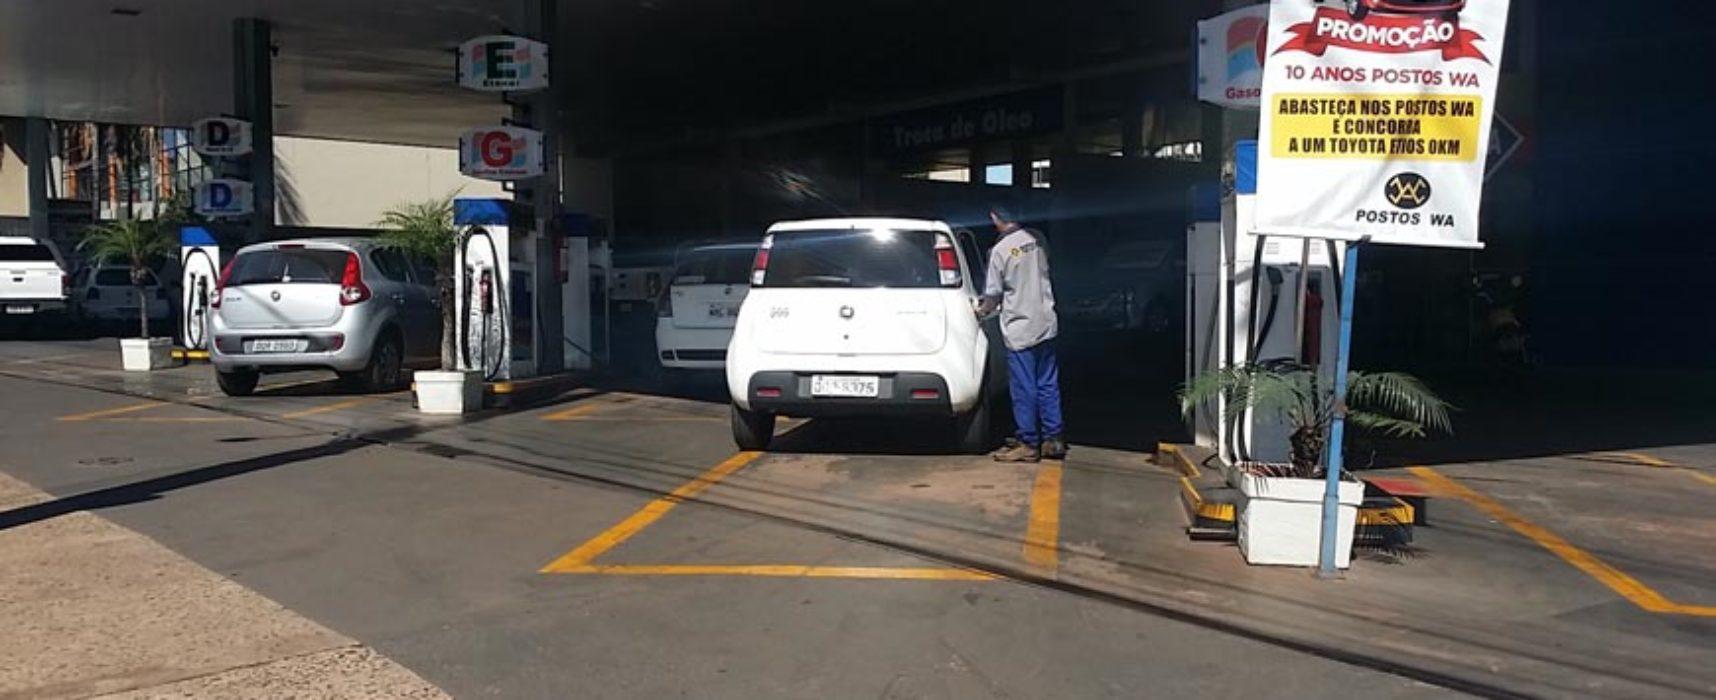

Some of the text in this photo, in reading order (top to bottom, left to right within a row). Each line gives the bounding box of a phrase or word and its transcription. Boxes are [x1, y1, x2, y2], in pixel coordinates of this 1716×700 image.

[1316, 17, 1454, 47] PROMOÇÃO
[485, 41, 517, 79] E
[1285, 65, 1480, 88] 10 ANOS POSTOS WA
[1279, 99, 1475, 118] ABASTEÇA NOS POSTOS WA
[207, 121, 229, 146] D
[1333, 119, 1341, 134] E
[481, 131, 513, 168] G
[1289, 138, 1298, 153] A
[1303, 138, 1327, 153] UM
[1329, 138, 1386, 154] TOYOTA
[210, 183, 232, 208] D
[1356, 209, 1455, 227] POSTOS WA
